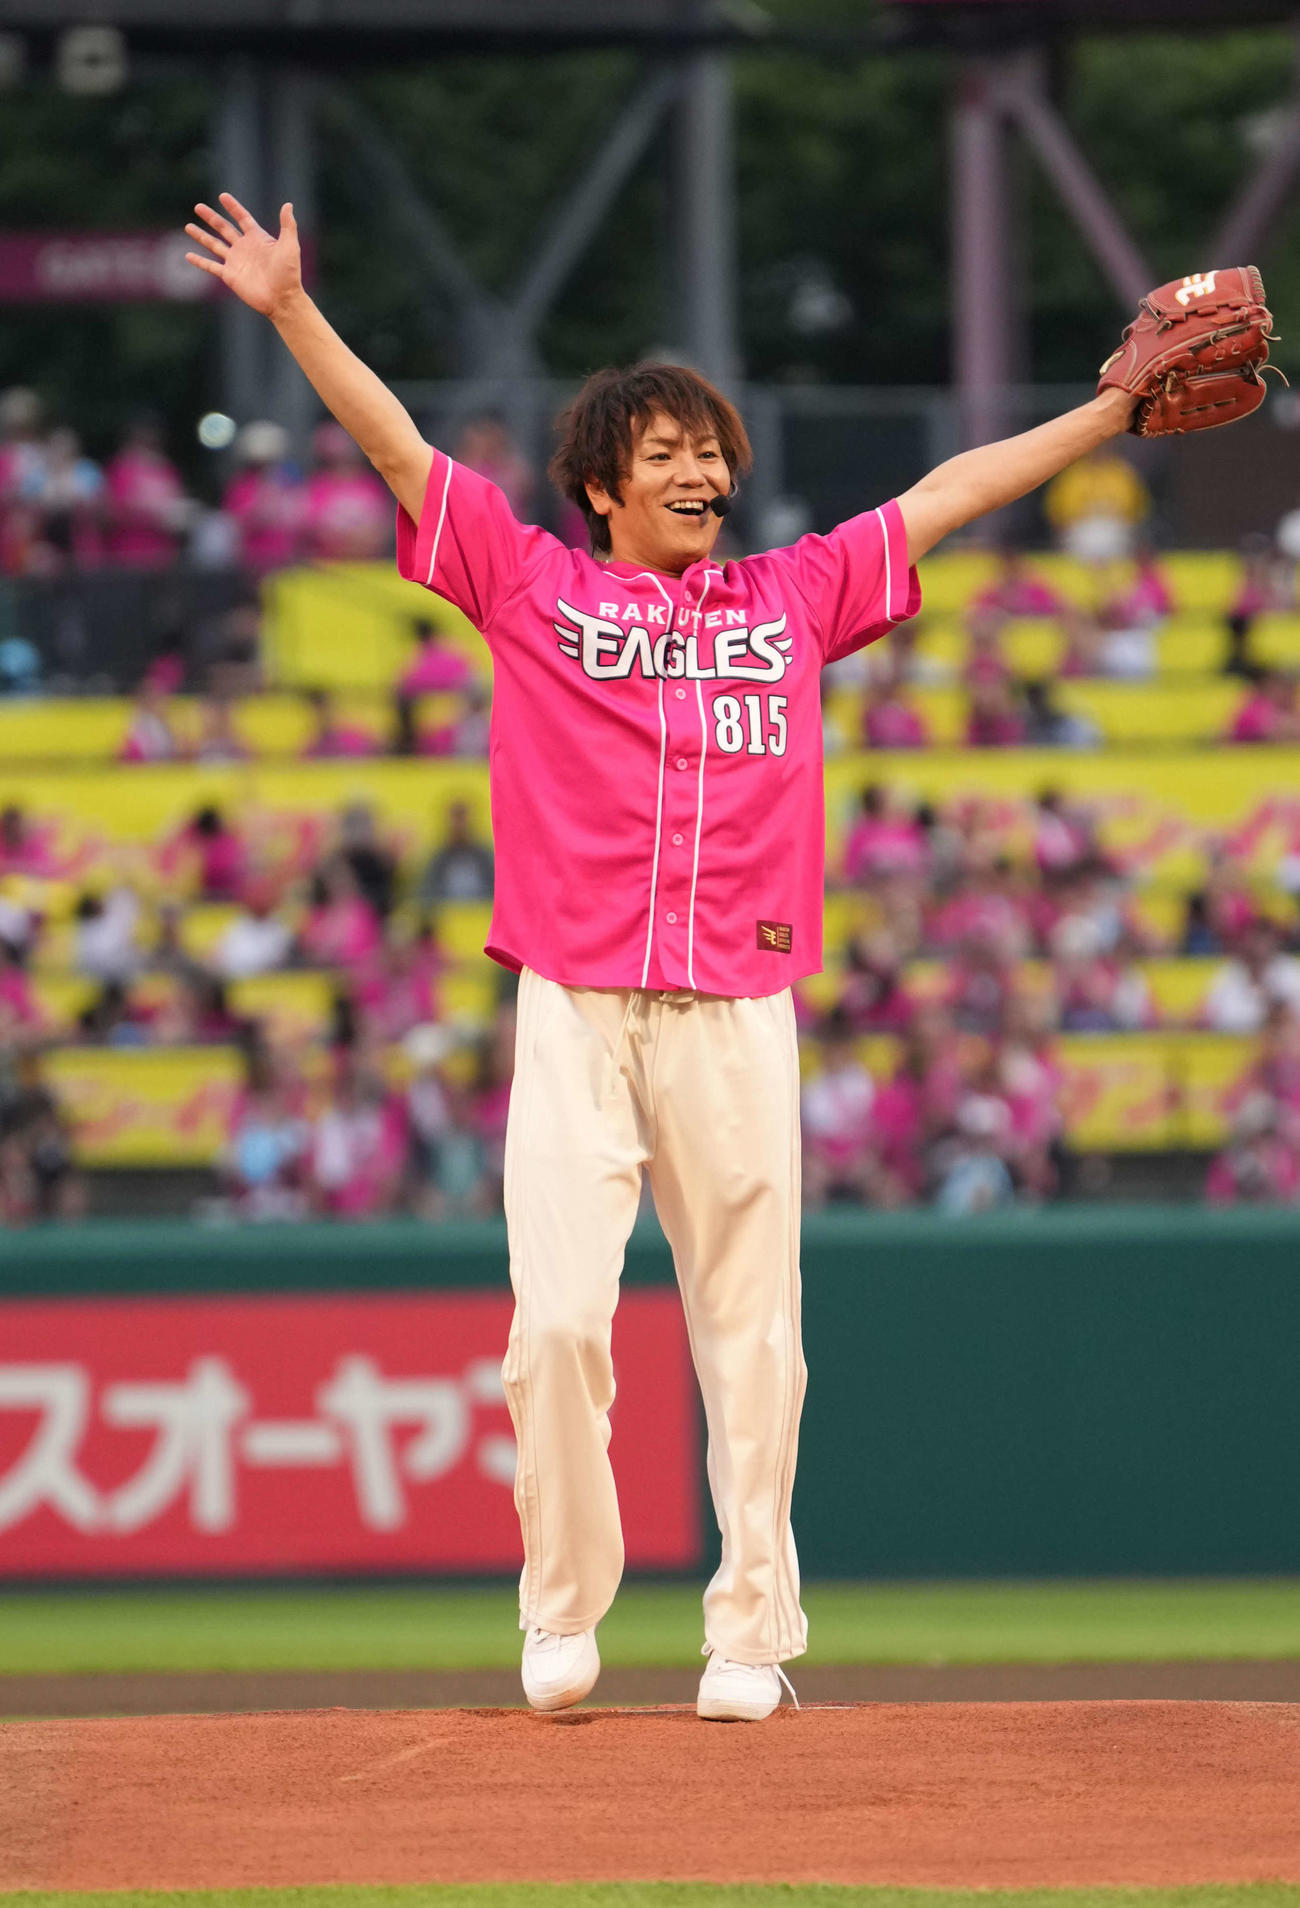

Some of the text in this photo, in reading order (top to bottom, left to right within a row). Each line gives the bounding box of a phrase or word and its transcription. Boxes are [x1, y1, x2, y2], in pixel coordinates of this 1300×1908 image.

[553, 597, 793, 683] EAGLES
[599, 602, 748, 628] RAKUTEN
[712, 695, 788, 757] 815
